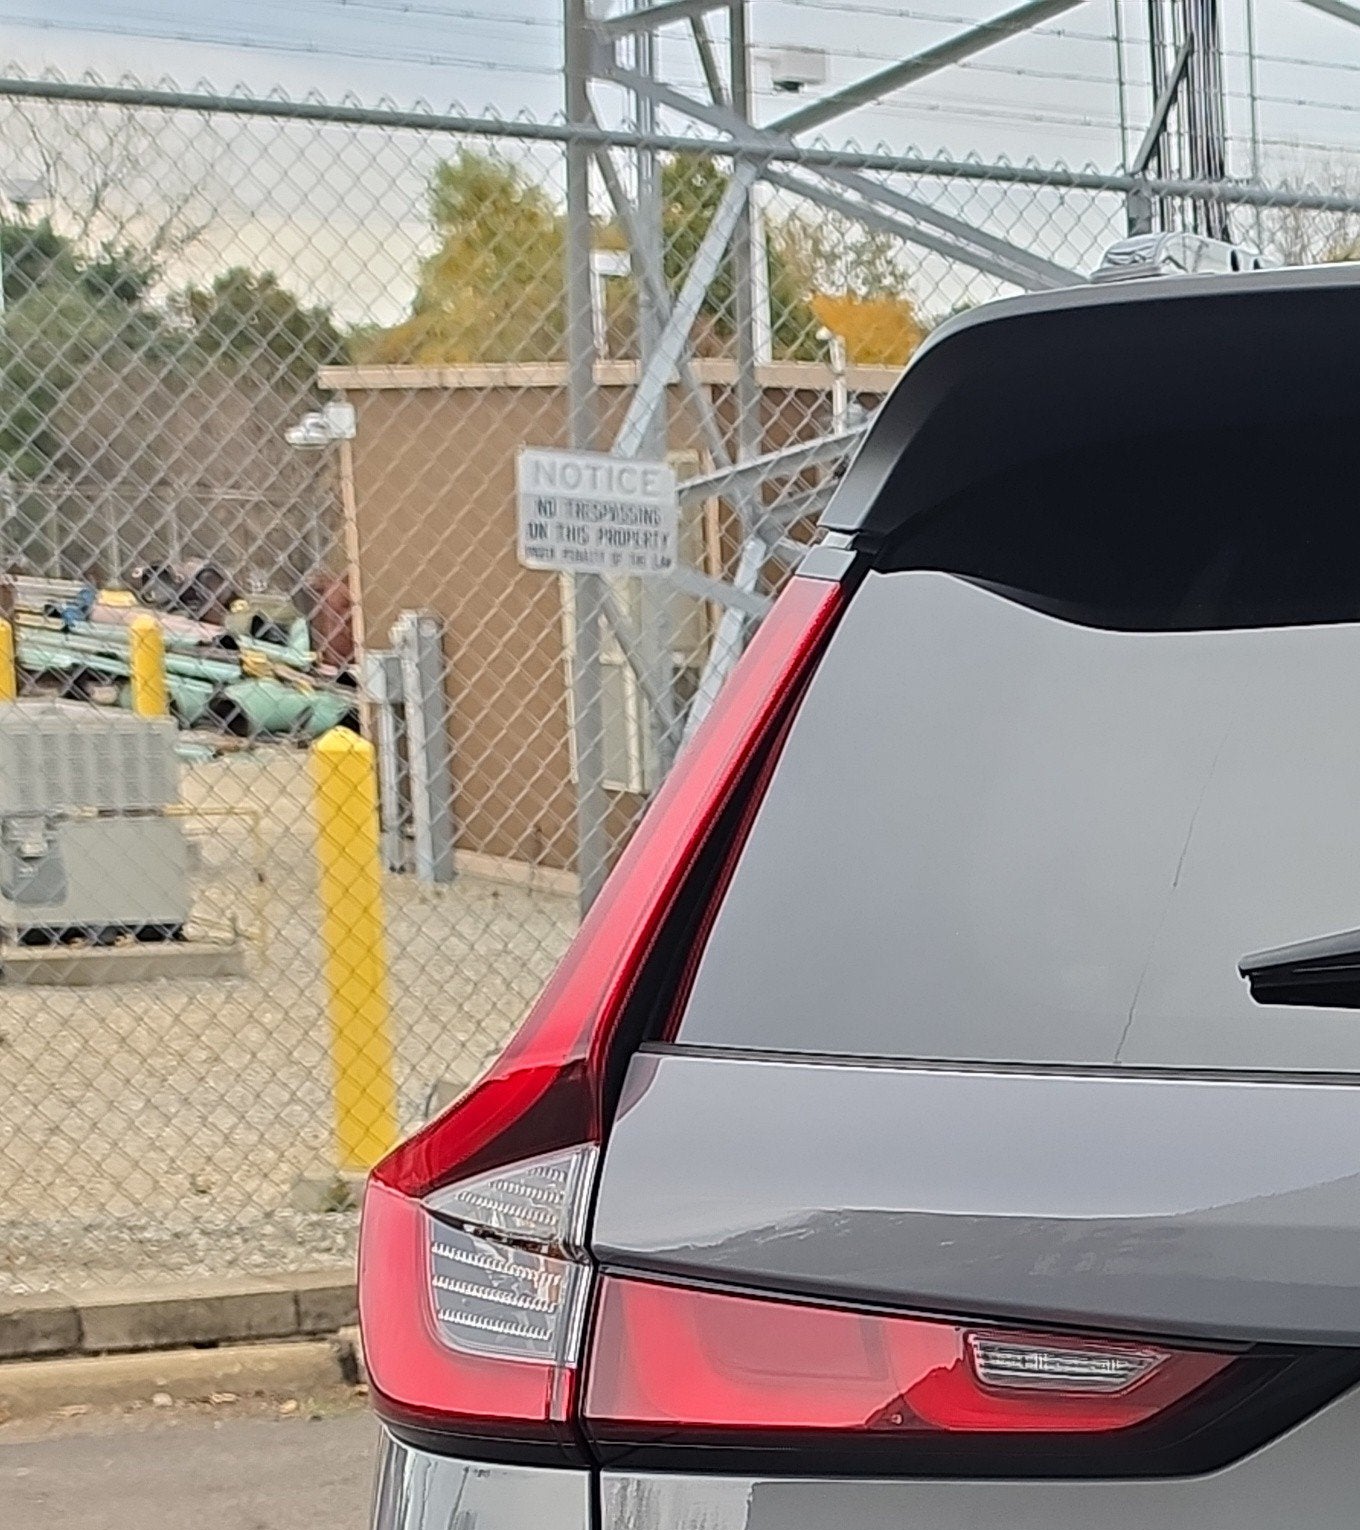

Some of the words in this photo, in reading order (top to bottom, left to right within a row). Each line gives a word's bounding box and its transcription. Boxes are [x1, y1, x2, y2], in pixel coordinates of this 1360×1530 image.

[533, 460, 661, 496] NOTICE
[536, 497, 557, 518] NO
[565, 501, 661, 525] TRESPASSING
[528, 522, 548, 541] ON
[557, 524, 590, 546] THIS
[599, 527, 670, 550] PROPERTY
